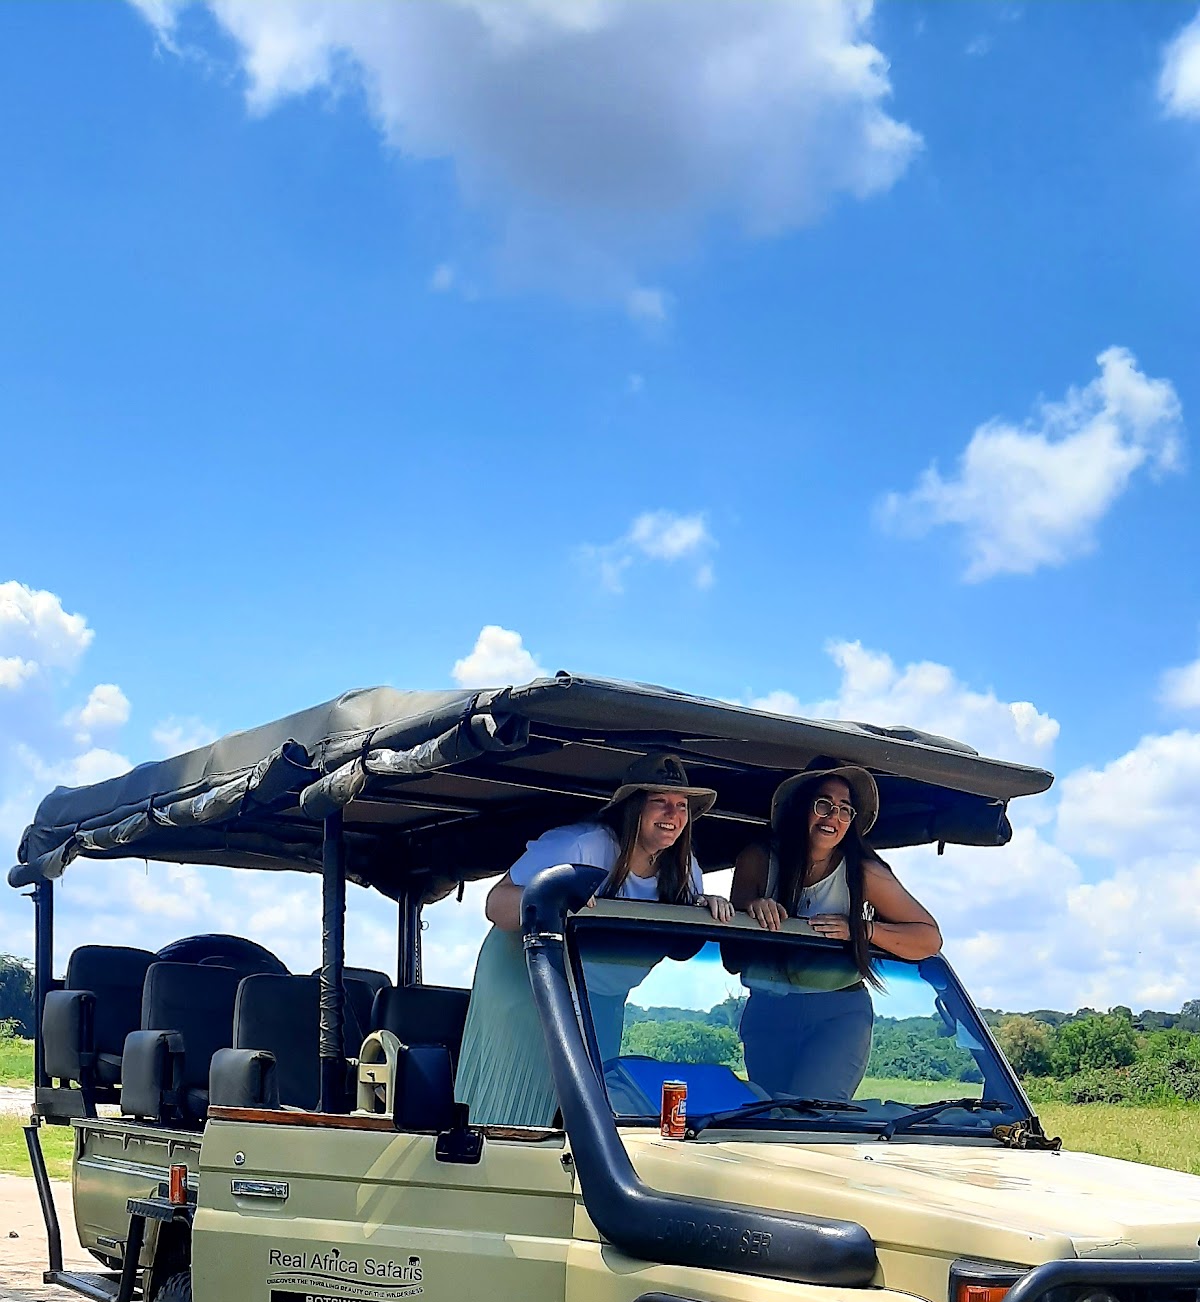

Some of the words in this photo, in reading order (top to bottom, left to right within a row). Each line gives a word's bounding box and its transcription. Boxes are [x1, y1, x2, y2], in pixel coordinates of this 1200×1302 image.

[269, 1249, 306, 1268] Real
[310, 1250, 358, 1274] Africa
[364, 1257, 423, 1281] Safaris
[309, 1279, 340, 1290] THRILLING
[340, 1285, 363, 1294] BEAUTY
